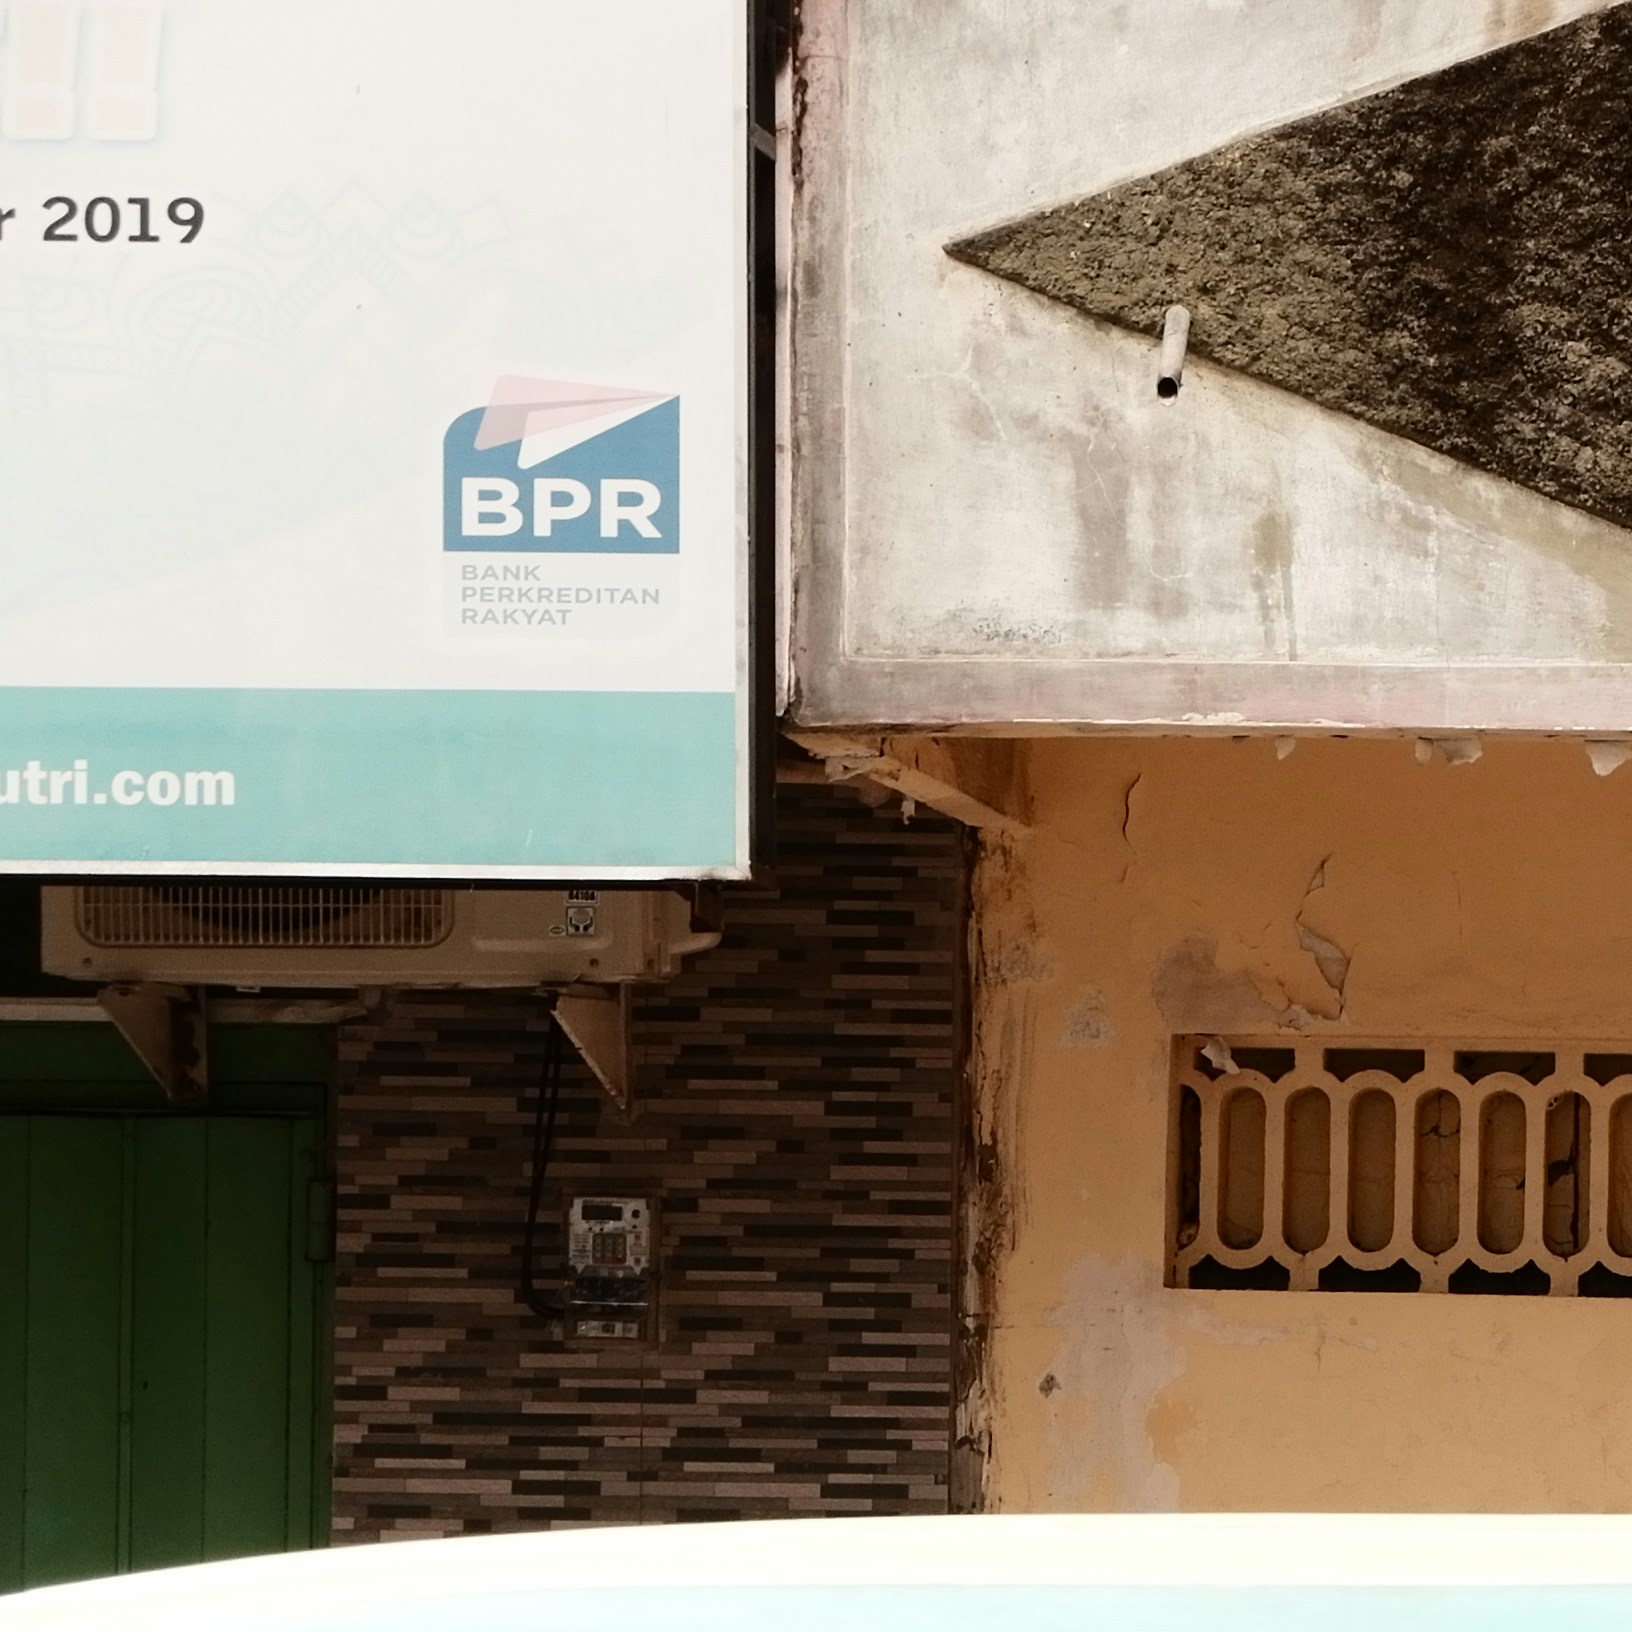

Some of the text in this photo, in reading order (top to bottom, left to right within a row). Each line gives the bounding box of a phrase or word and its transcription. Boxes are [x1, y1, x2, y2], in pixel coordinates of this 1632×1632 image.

[42, 195, 205, 243] 2019
[461, 477, 663, 538] BPR
[461, 564, 541, 581] BANK
[461, 587, 660, 604] PERKREDITAN
[461, 608, 572, 625] RAKYAT
